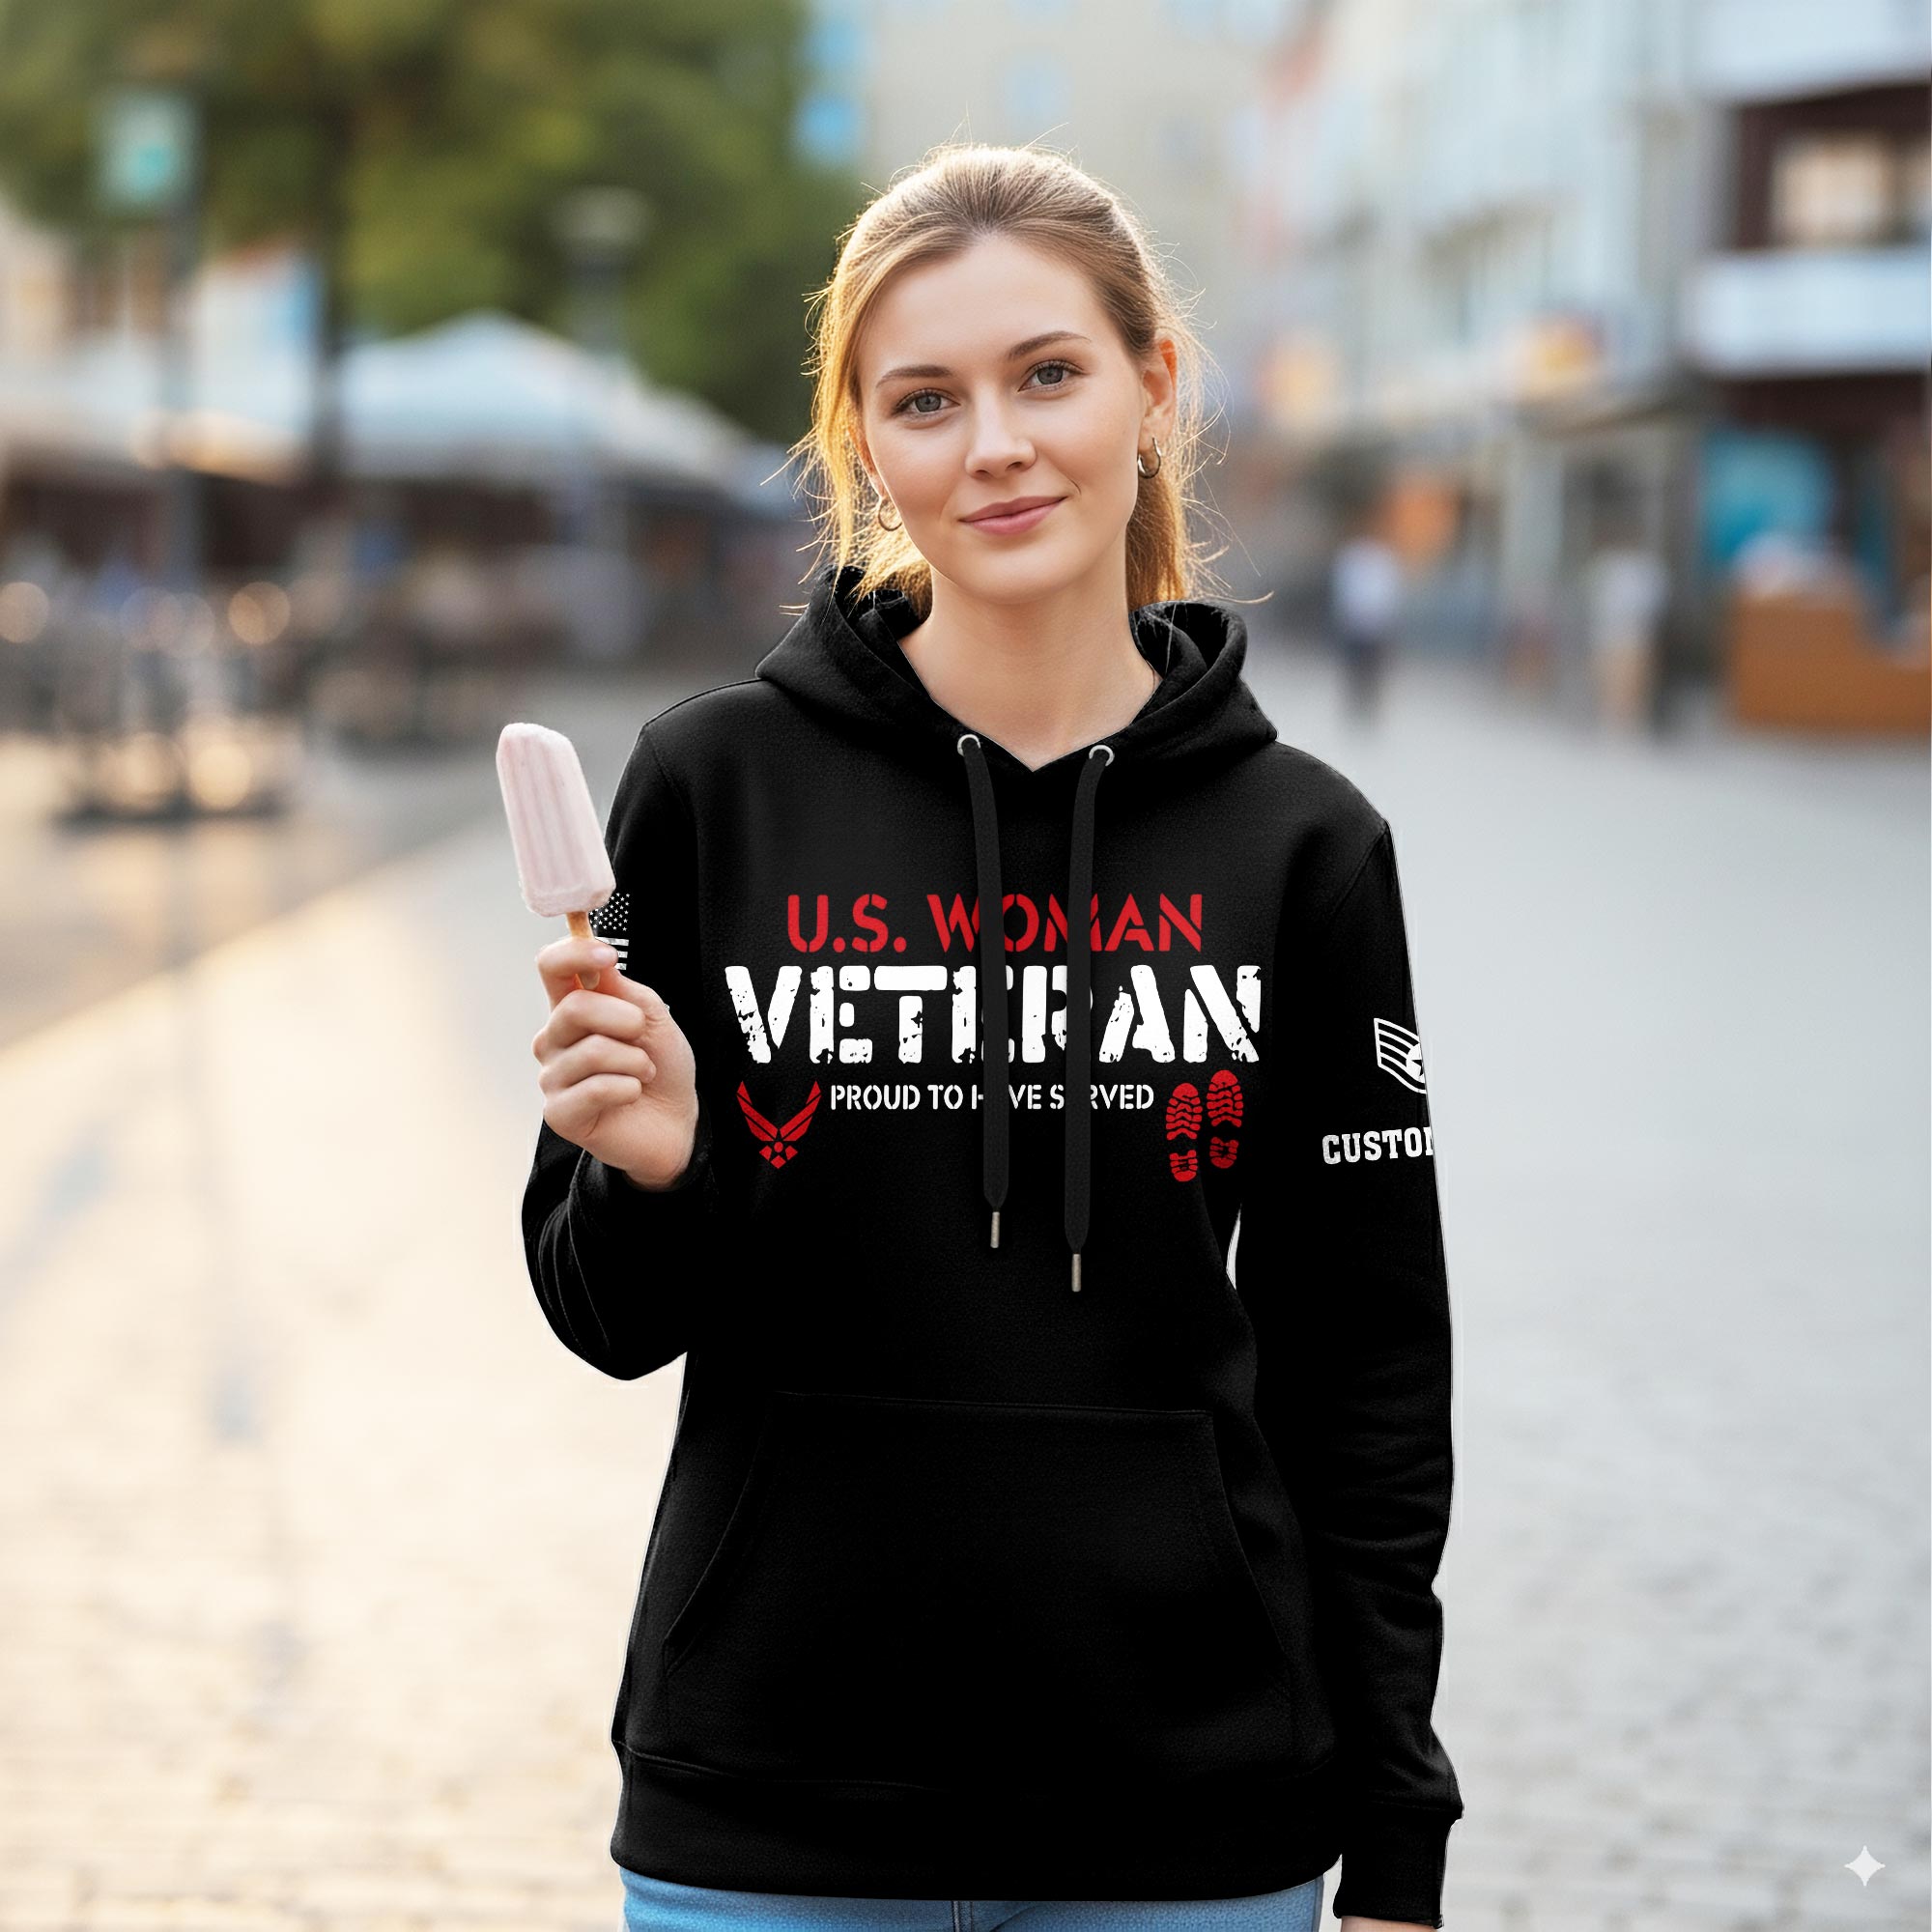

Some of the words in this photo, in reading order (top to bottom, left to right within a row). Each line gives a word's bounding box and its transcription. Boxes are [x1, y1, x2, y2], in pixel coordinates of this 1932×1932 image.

[788, 895, 906, 952] U.S.
[831, 1085, 920, 1110] PROUD
[927, 1085, 963, 1110] TO
[1049, 1085, 1154, 1110] SRVED
